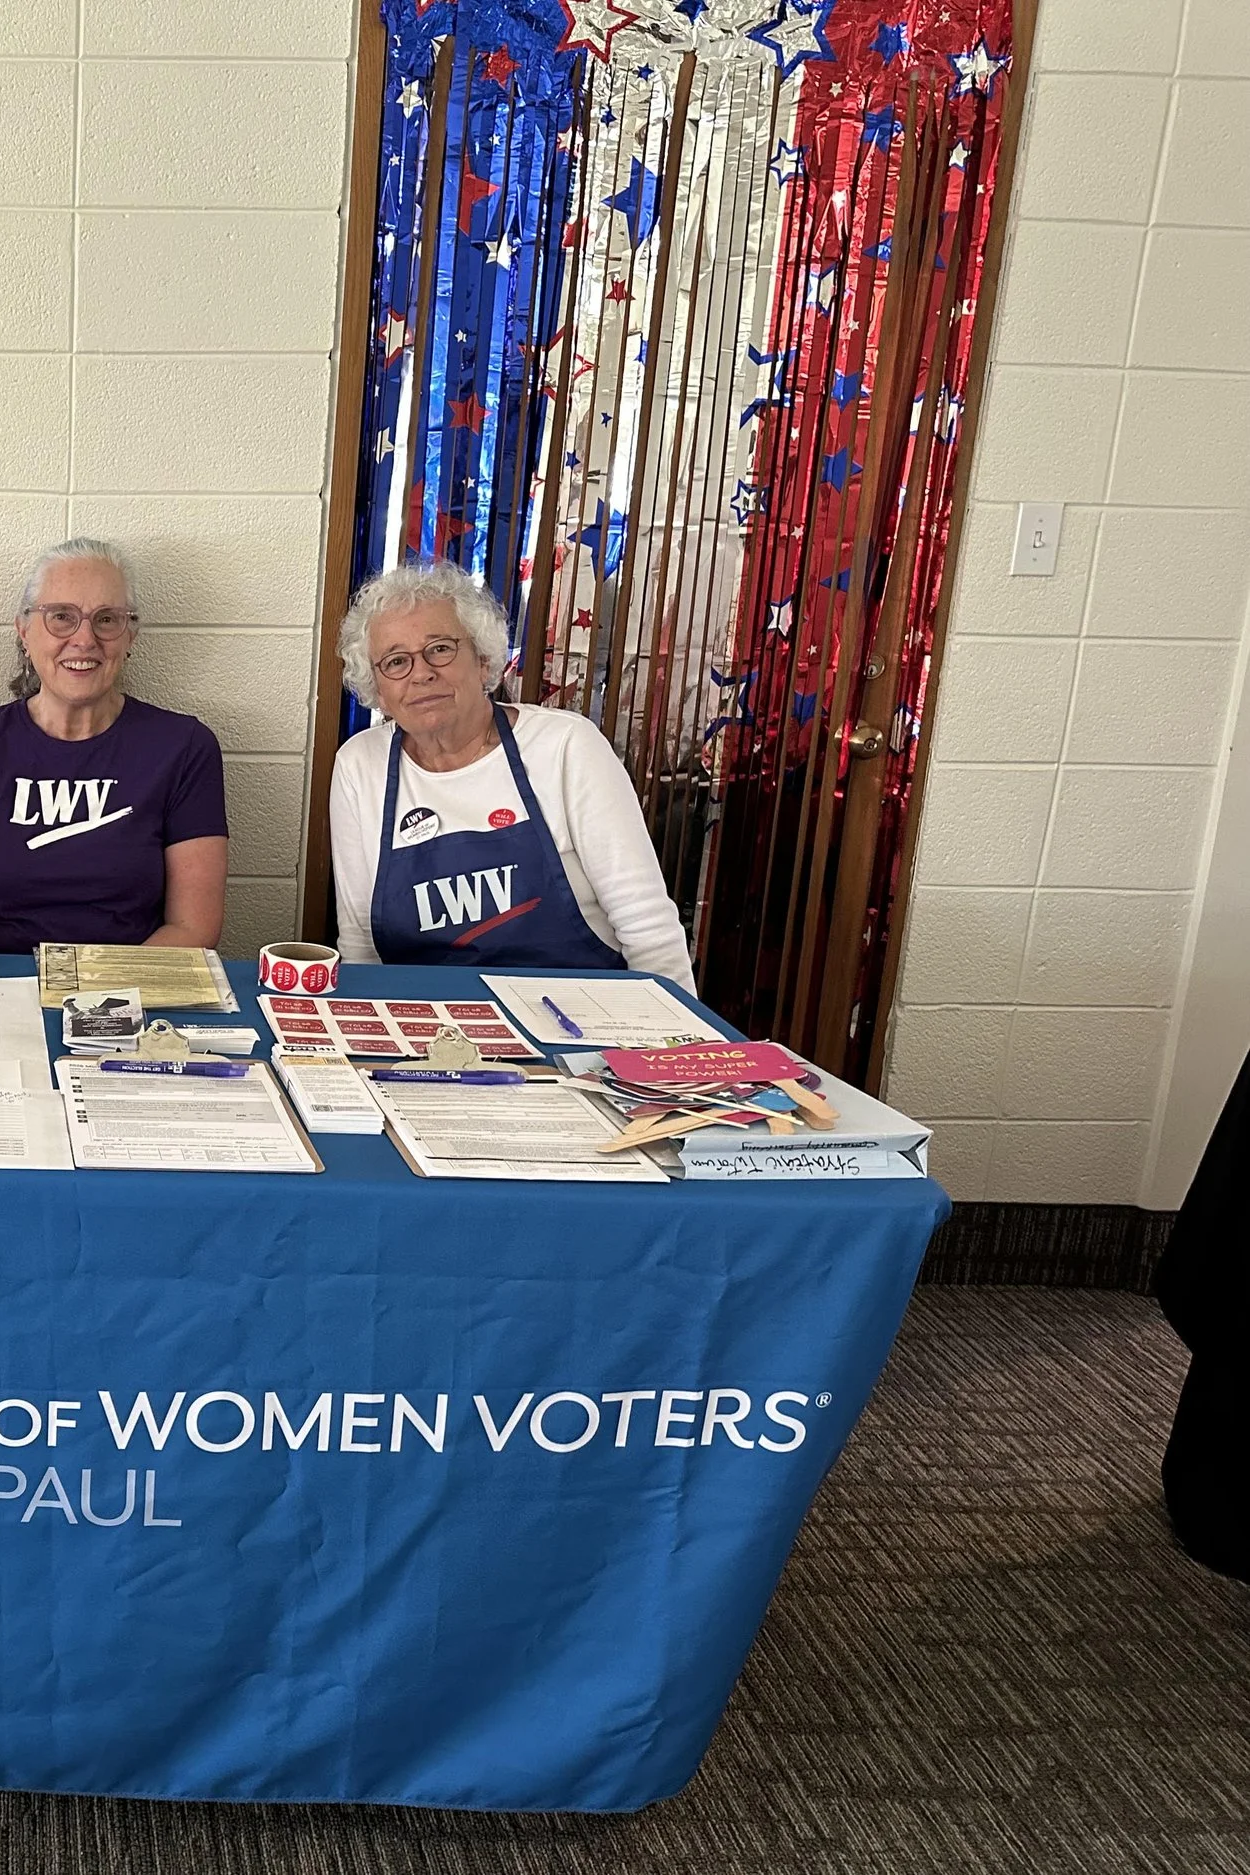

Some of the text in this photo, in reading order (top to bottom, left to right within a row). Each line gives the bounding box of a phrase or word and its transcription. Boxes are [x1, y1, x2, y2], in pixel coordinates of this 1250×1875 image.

[9, 777, 114, 826] LWV
[406, 811, 424, 826] LWV
[413, 864, 515, 932] LWV
[641, 1050, 747, 1062] VOTING
[704, 1061, 759, 1070] SUPER
[99, 1391, 448, 1454] WOMEN
